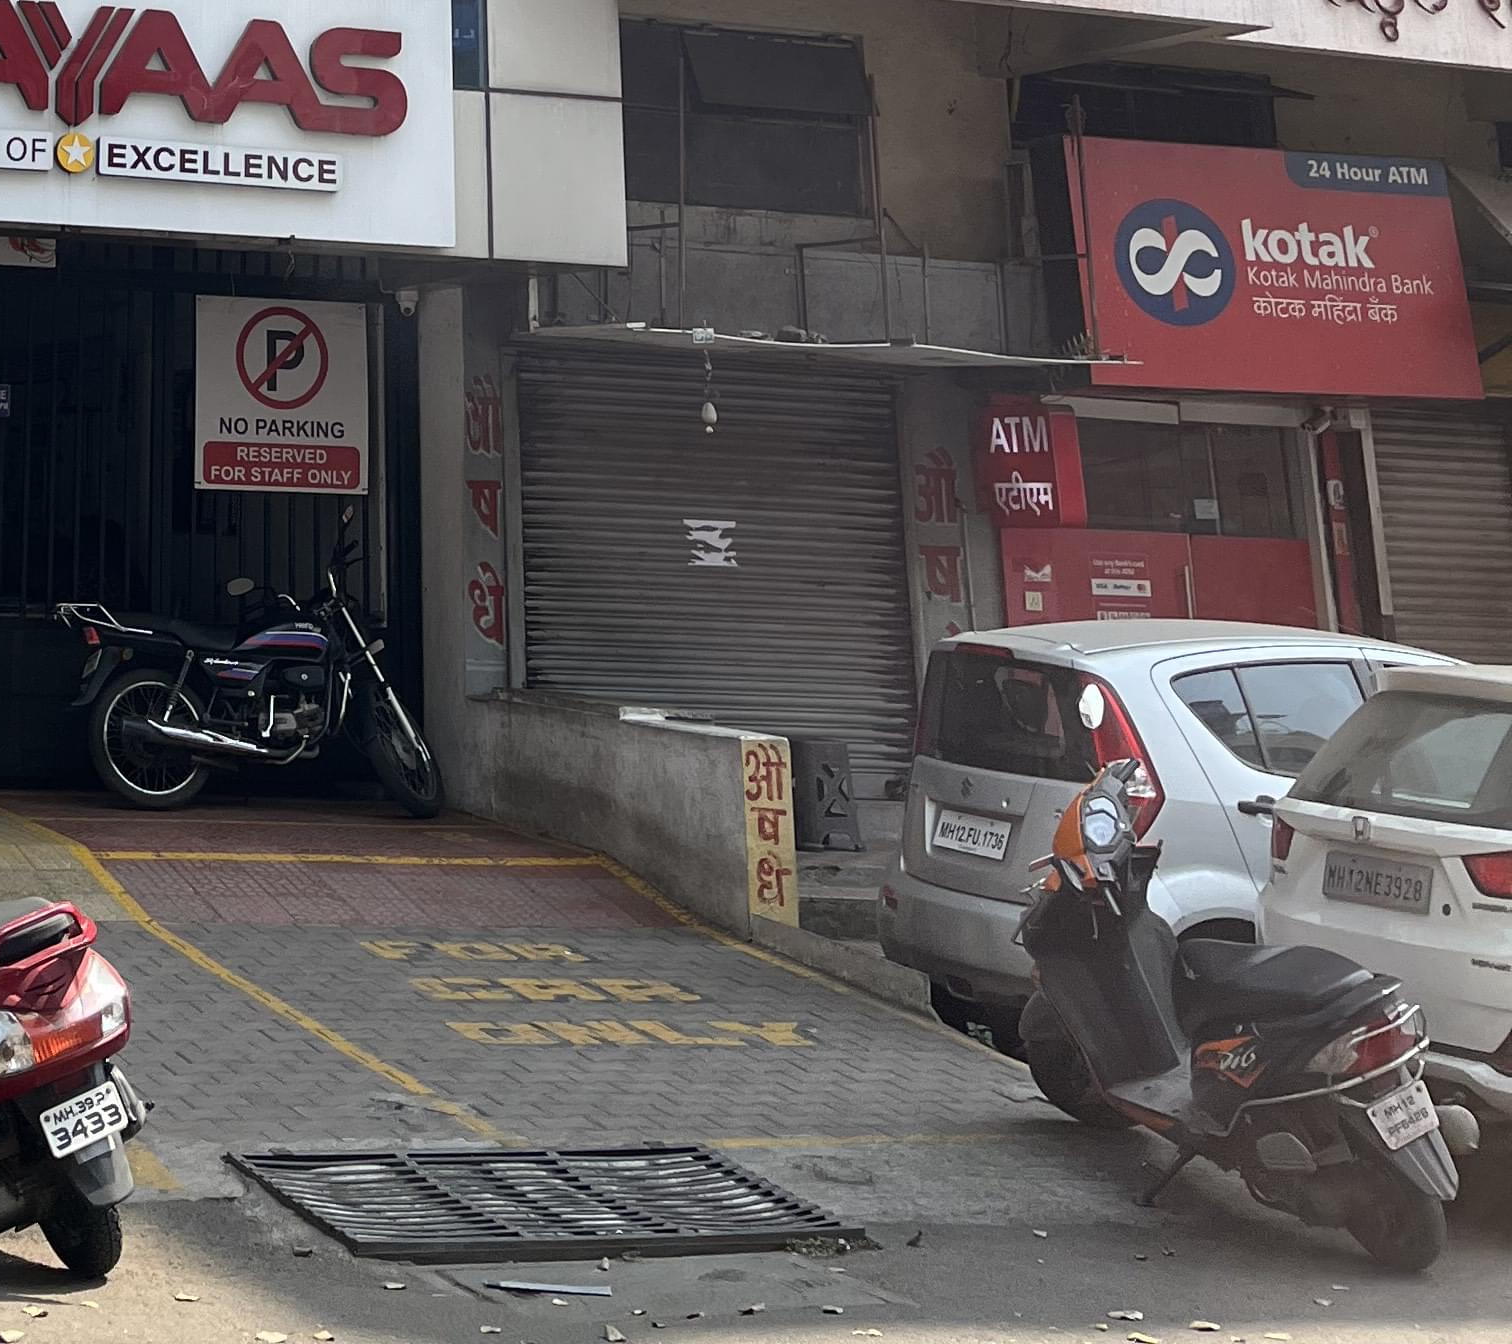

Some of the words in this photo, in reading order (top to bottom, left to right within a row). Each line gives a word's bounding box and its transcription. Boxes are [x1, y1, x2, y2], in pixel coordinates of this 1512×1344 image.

[5, 136, 48, 163] OF
[106, 143, 337, 185] EXCELLENCE
[1307, 160, 1331, 179] 24
[1336, 162, 1382, 182] Hour
[1388, 166, 1429, 185] ATM
[1241, 218, 1375, 269] kotak
[1247, 266, 1299, 288] Kotak
[1303, 269, 1387, 293] Mahindra
[1391, 274, 1434, 296] Bank
[1252, 291, 1306, 319] कोटक
[219, 417, 249, 435] NO
[255, 418, 345, 439] PARKING
[990, 416, 1049, 453] ATM
[237, 446, 327, 464] RESERVED
[210, 465, 246, 481] FOR
[250, 467, 303, 483] STAFF
[308, 469, 352, 485] ONLY
[994, 471, 1054, 517] एटीएम
[360, 940, 589, 962] FOR
[408, 977, 702, 1002] CAR
[445, 1020, 816, 1046] ONLY
[50, 1103, 122, 1151] 3433
